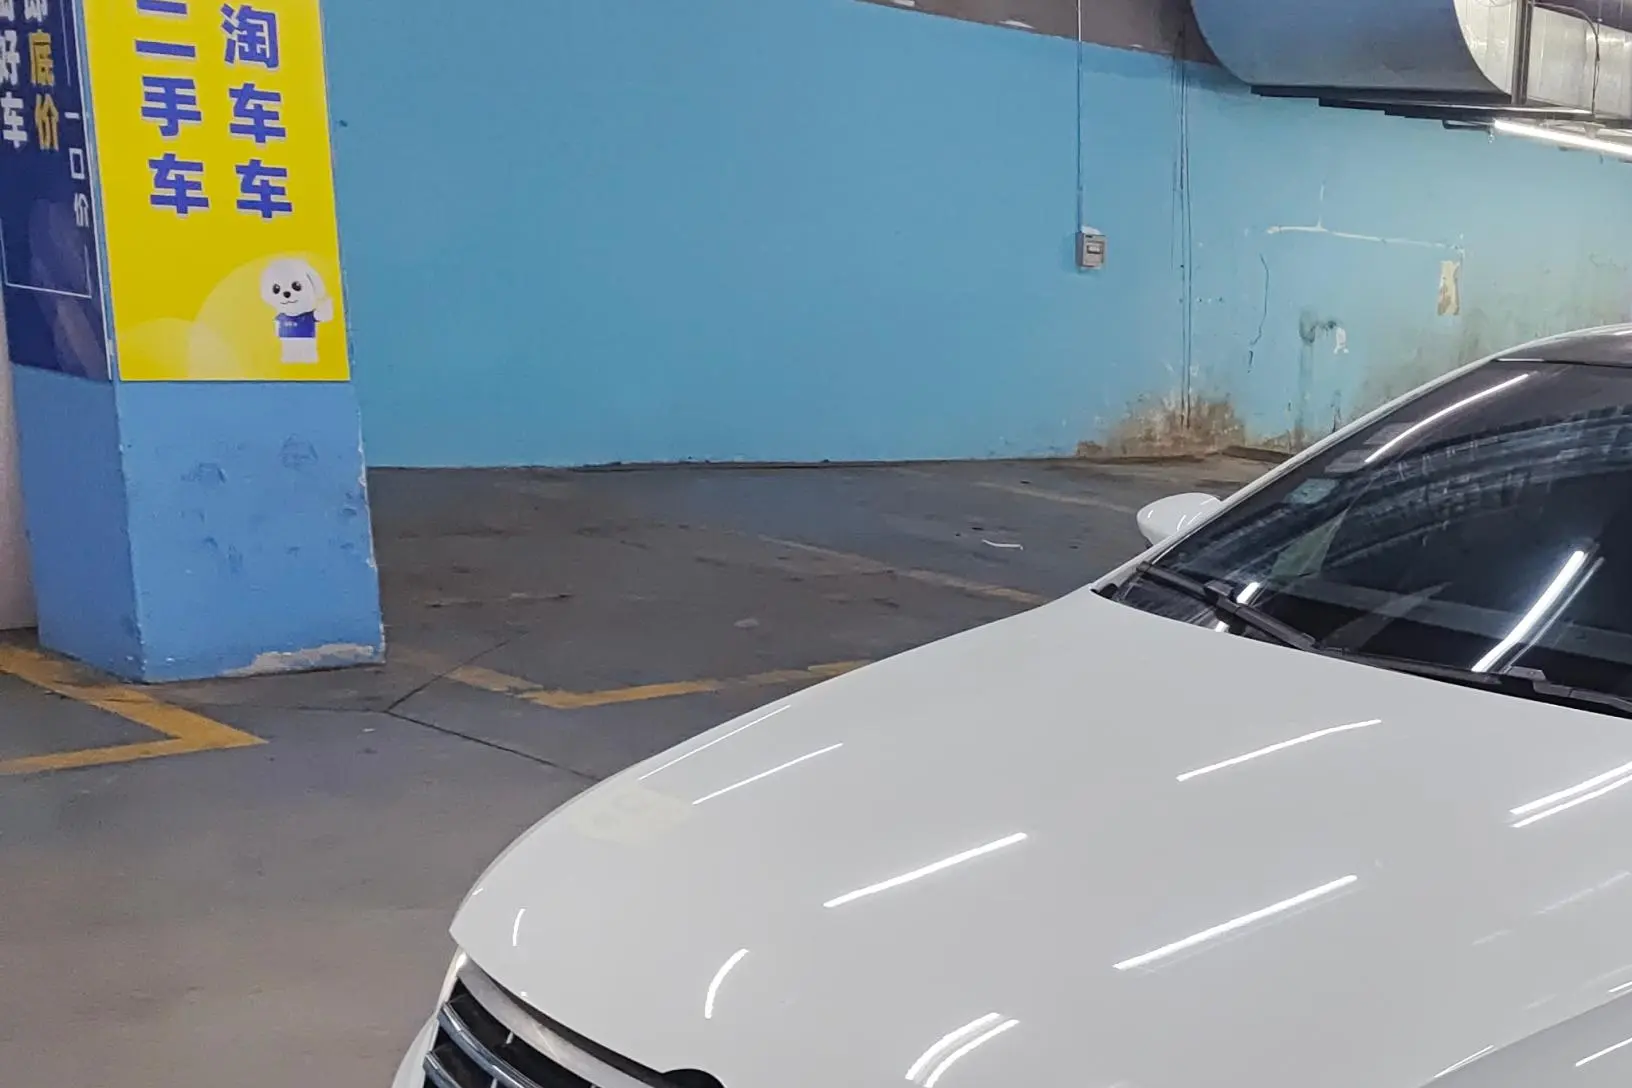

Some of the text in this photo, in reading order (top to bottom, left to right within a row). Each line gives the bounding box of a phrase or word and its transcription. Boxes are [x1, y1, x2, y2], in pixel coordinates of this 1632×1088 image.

[0, 0, 28, 148] 好车
[220, 3, 293, 220] 淘车车
[65, 112, 89, 228] 一口价
